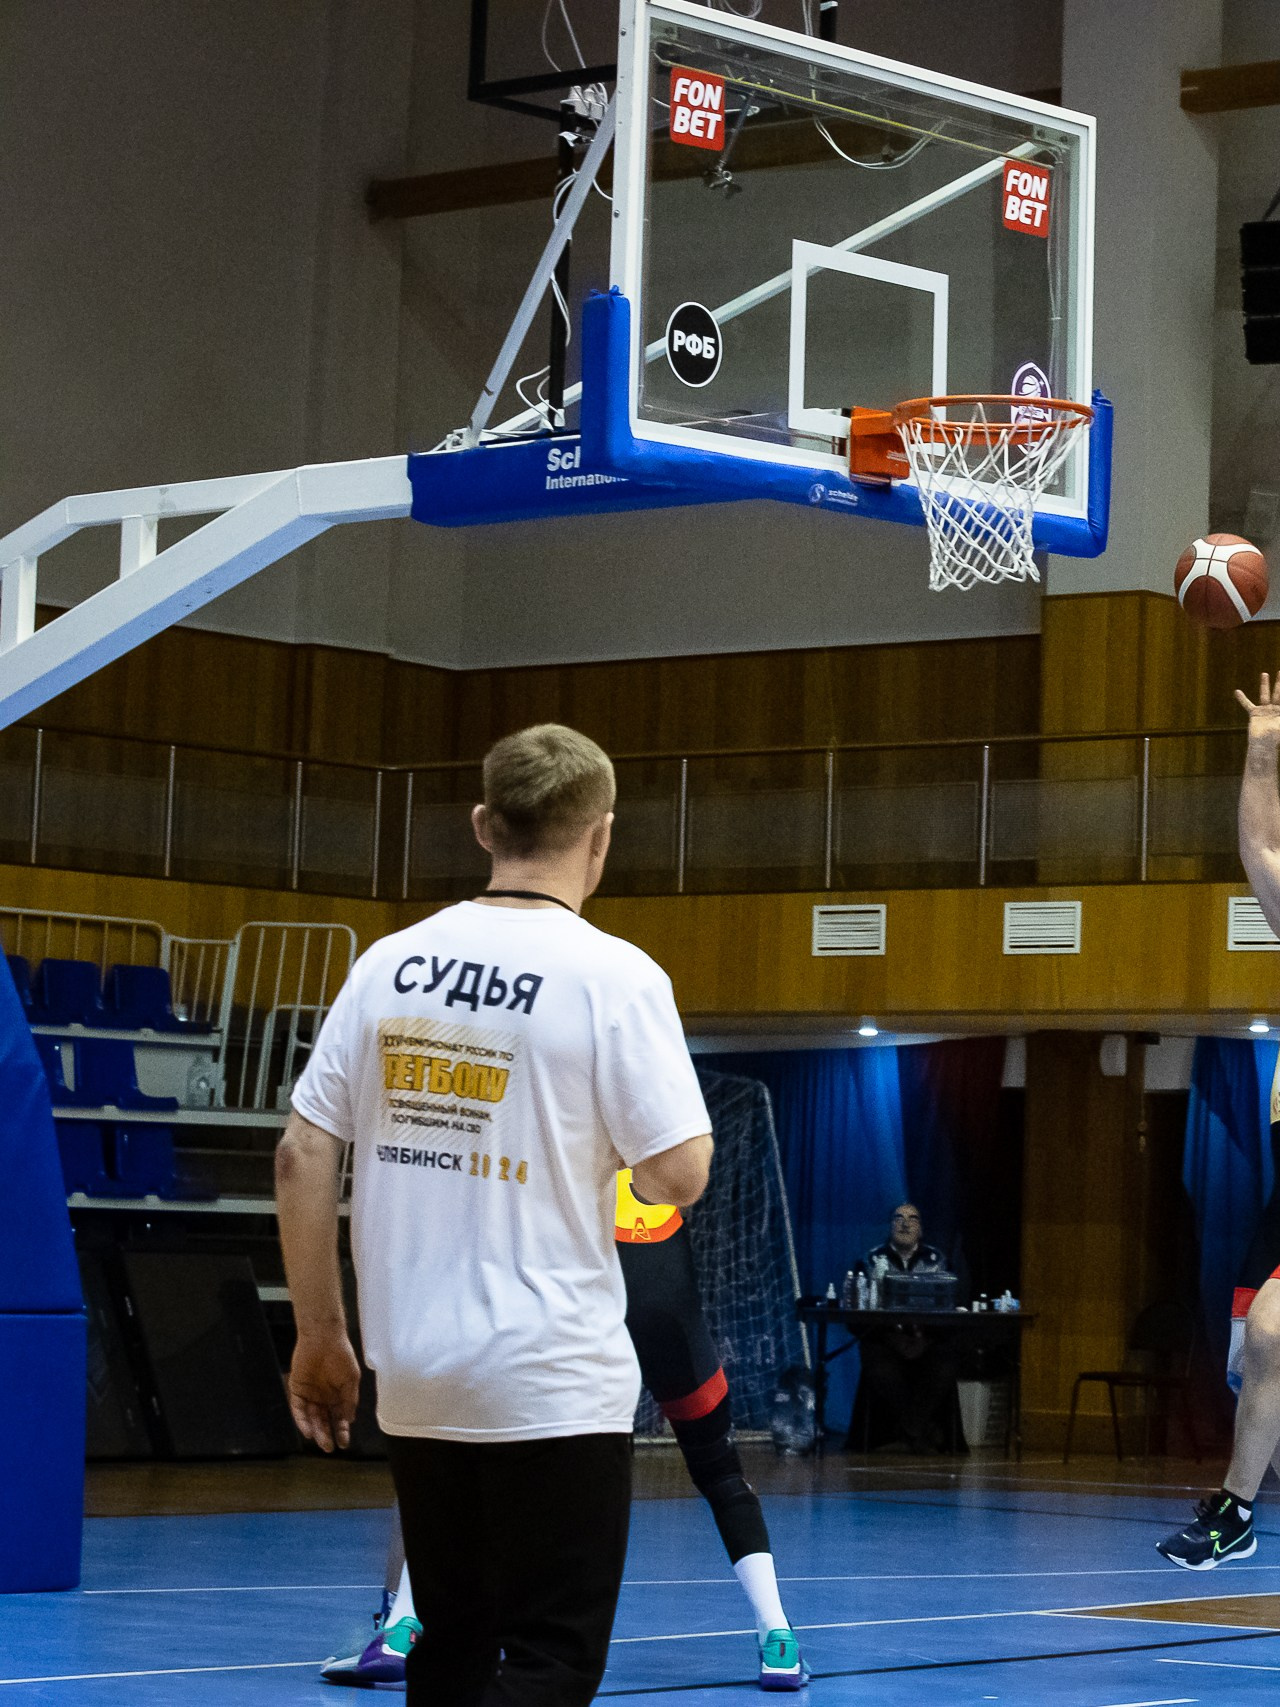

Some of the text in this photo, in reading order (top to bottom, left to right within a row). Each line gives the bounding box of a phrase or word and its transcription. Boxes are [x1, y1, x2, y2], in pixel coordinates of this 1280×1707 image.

[673, 77, 723, 111] FON
[673, 105, 722, 140] BET
[1005, 168, 1048, 201] FON
[1004, 194, 1047, 228] BET
[673, 329, 716, 359] РФБ
[394, 955, 544, 1015] СУДЬЯ
